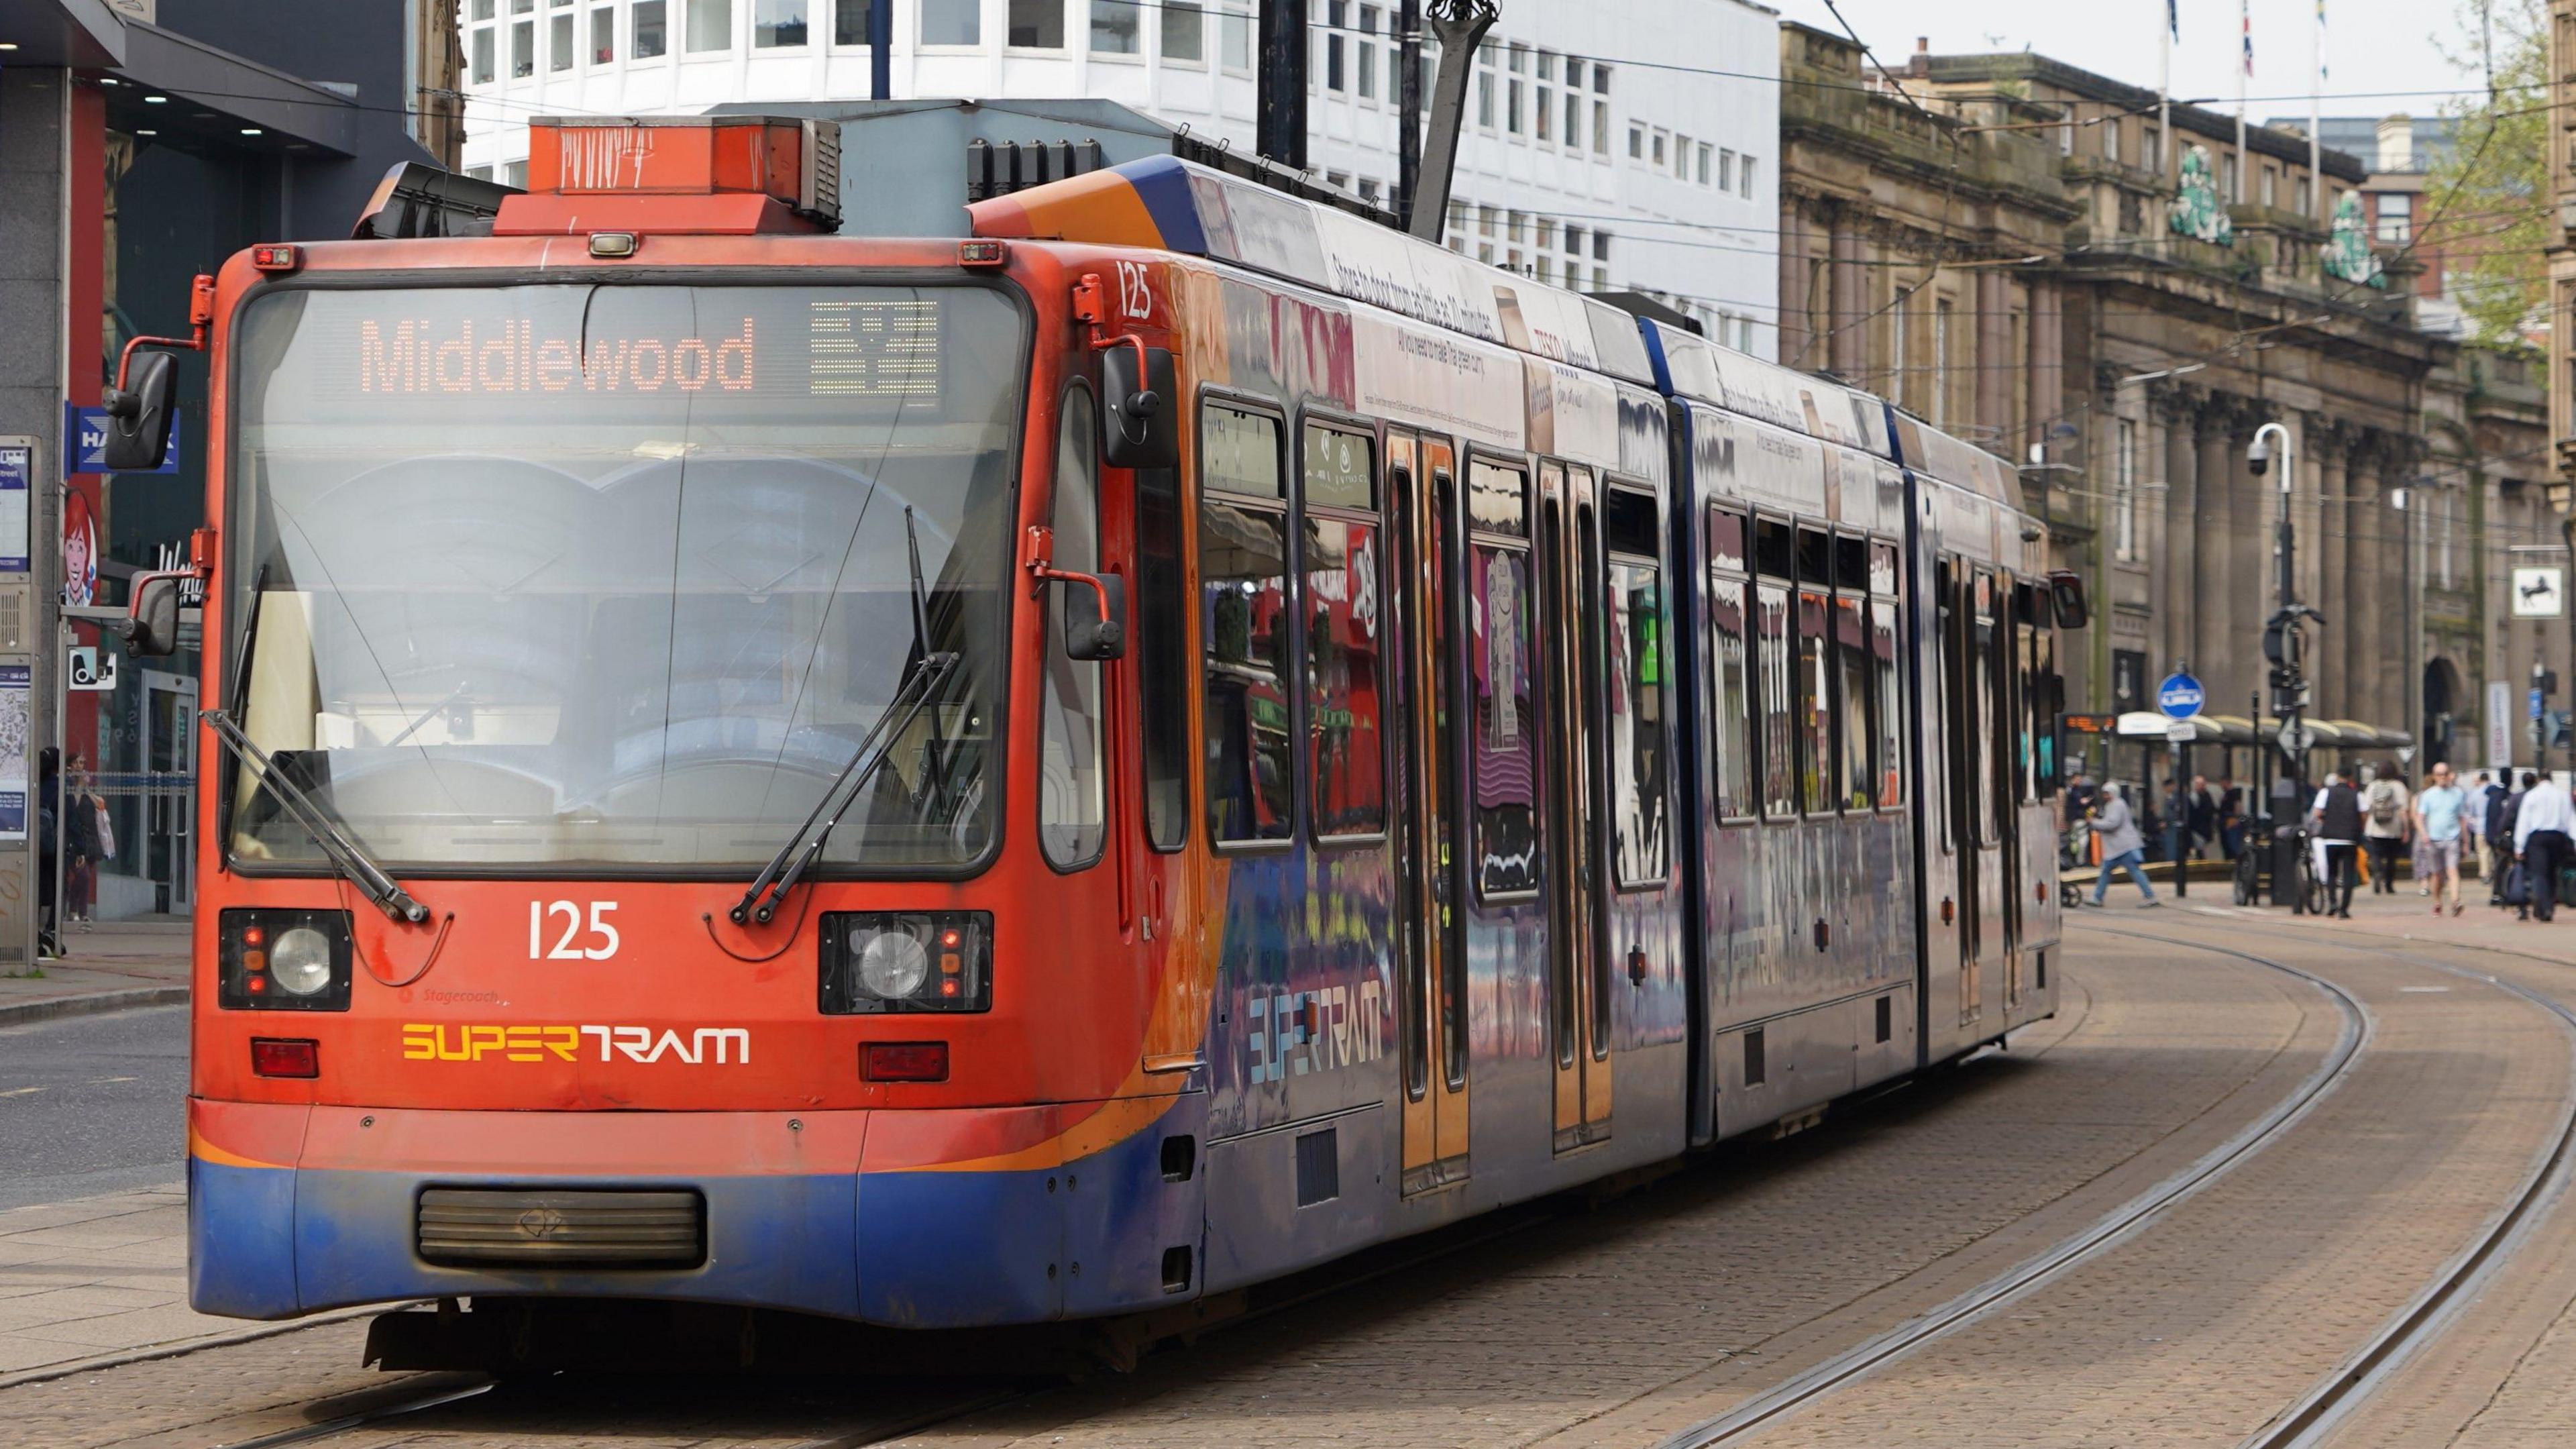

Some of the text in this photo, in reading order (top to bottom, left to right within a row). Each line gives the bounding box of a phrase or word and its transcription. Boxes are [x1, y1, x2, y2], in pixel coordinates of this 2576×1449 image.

[1116, 260, 1152, 321] 125
[1332, 253, 1362, 299] Store
[1356, 262, 1373, 303] to
[1370, 266, 1391, 309] door
[1388, 272, 1414, 317] from
[1411, 289, 1424, 321] as
[1419, 282, 1442, 326] little
[1440, 300, 1452, 329] as
[1460, 299, 1497, 344] minutes
[361, 316, 754, 392] Middlewood
[1534, 329, 1591, 370] TESCO Whoosh
[529, 900, 620, 961] 125
[423, 988, 498, 1006] Stagecoach
[402, 1023, 750, 1064] SUPERTRAM
[1249, 979, 1383, 1085] SUPERTRAM
